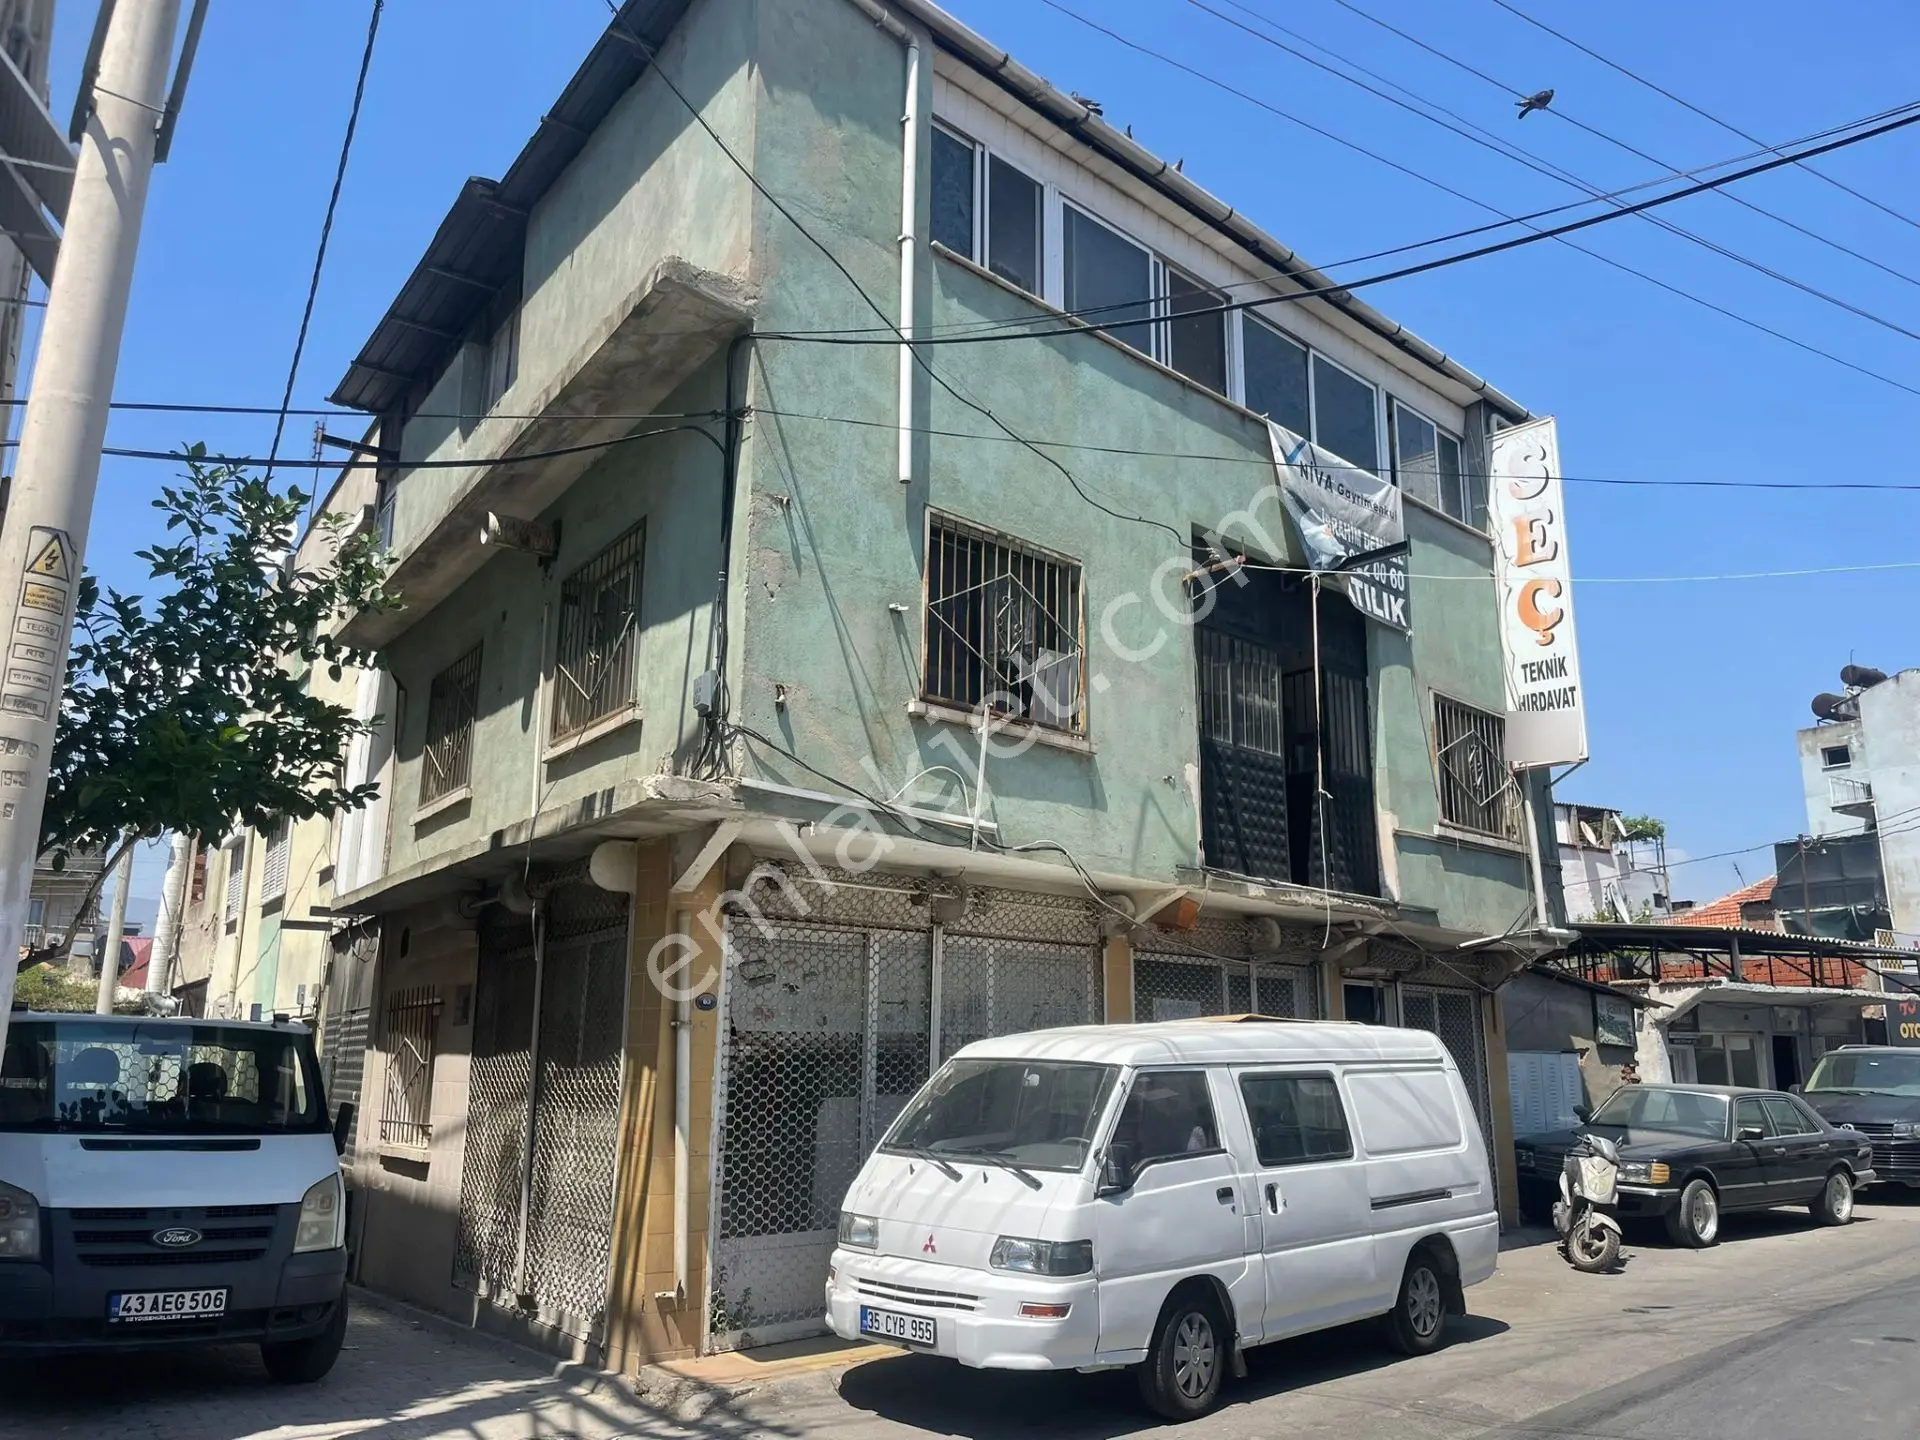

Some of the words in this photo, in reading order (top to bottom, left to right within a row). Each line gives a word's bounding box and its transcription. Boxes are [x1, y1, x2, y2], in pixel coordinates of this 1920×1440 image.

[1337, 483, 1398, 523] Gayrimenkul
[1521, 652, 1568, 684] TEKNİK
[1518, 686, 1577, 712] HIRDAVAT
[163, 1231, 191, 1242] Ford
[121, 1295, 145, 1314] 43
[149, 1293, 186, 1313] AEG
[188, 1291, 224, 1310] 506
[868, 1311, 880, 1330] 35
[886, 1315, 905, 1335] CYB
[911, 1319, 932, 1341] 955
